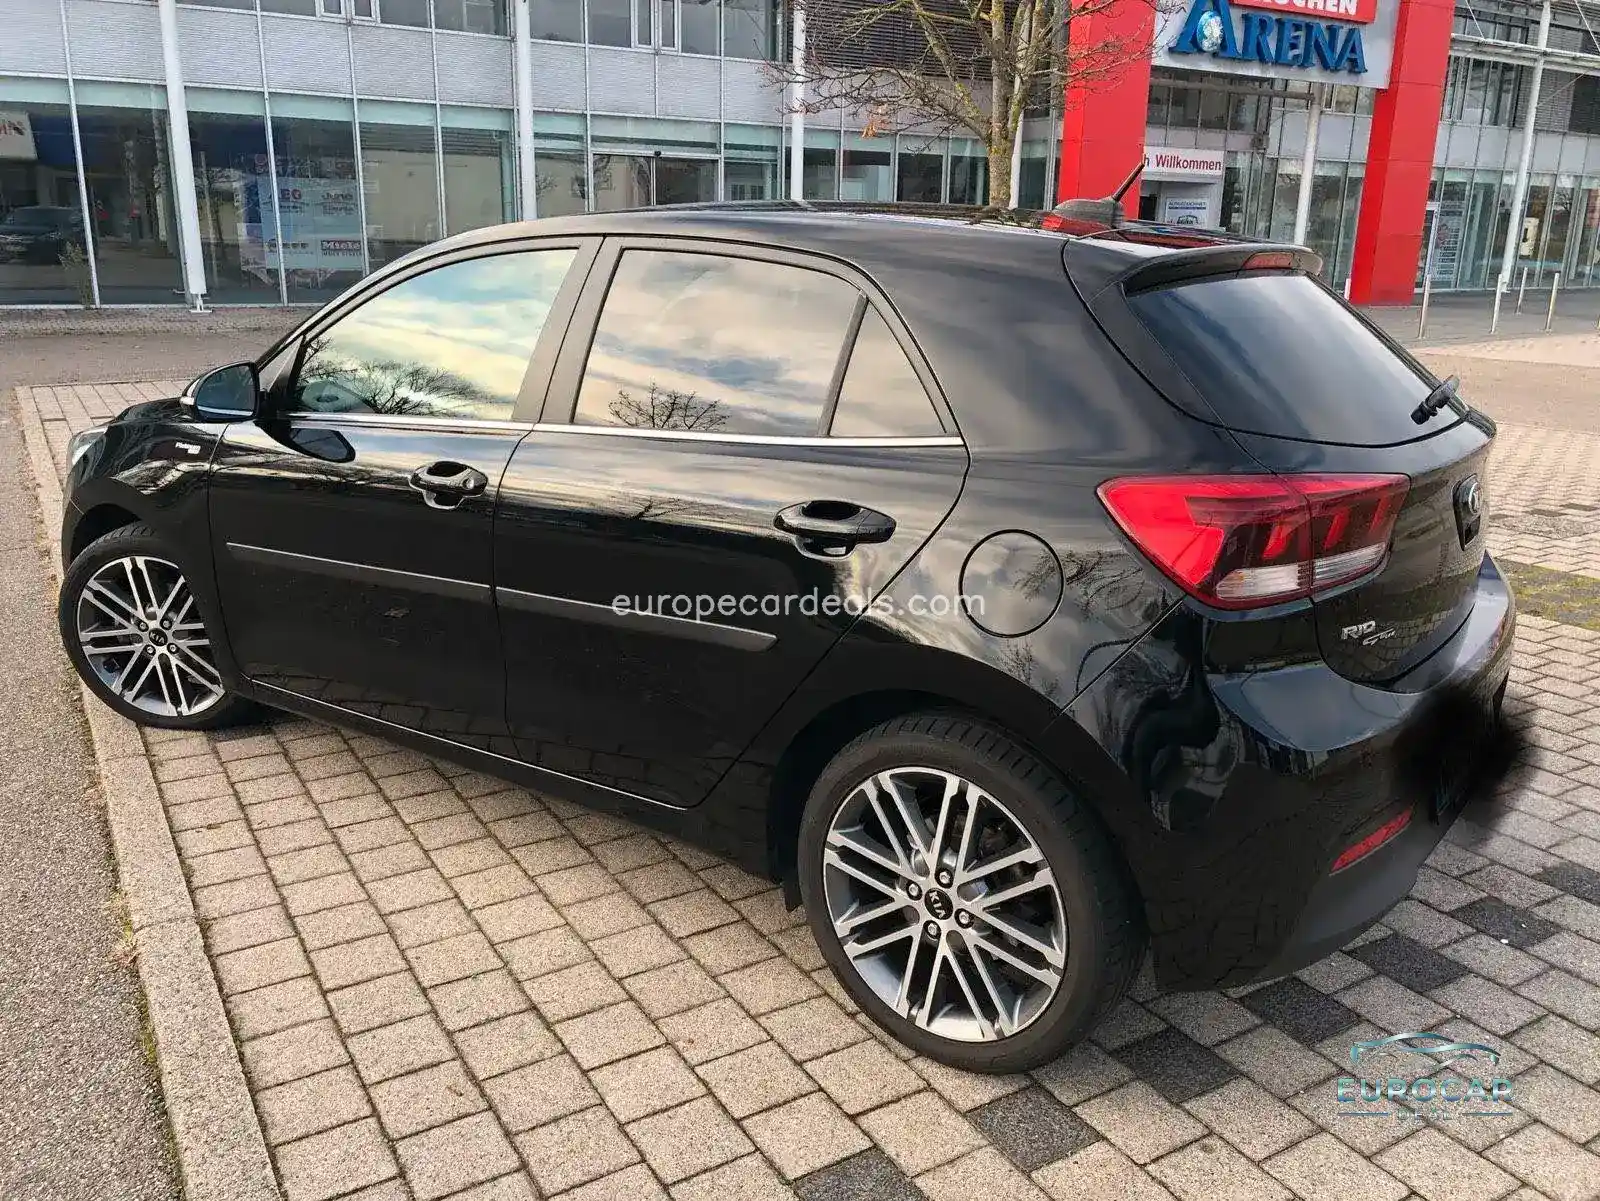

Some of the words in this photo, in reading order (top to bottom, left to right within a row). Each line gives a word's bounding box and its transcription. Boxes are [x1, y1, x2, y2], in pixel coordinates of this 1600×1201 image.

[1168, 0, 1368, 73] ARENA
[1156, 154, 1221, 170] Willkommen
[929, 890, 946, 919] KIA
